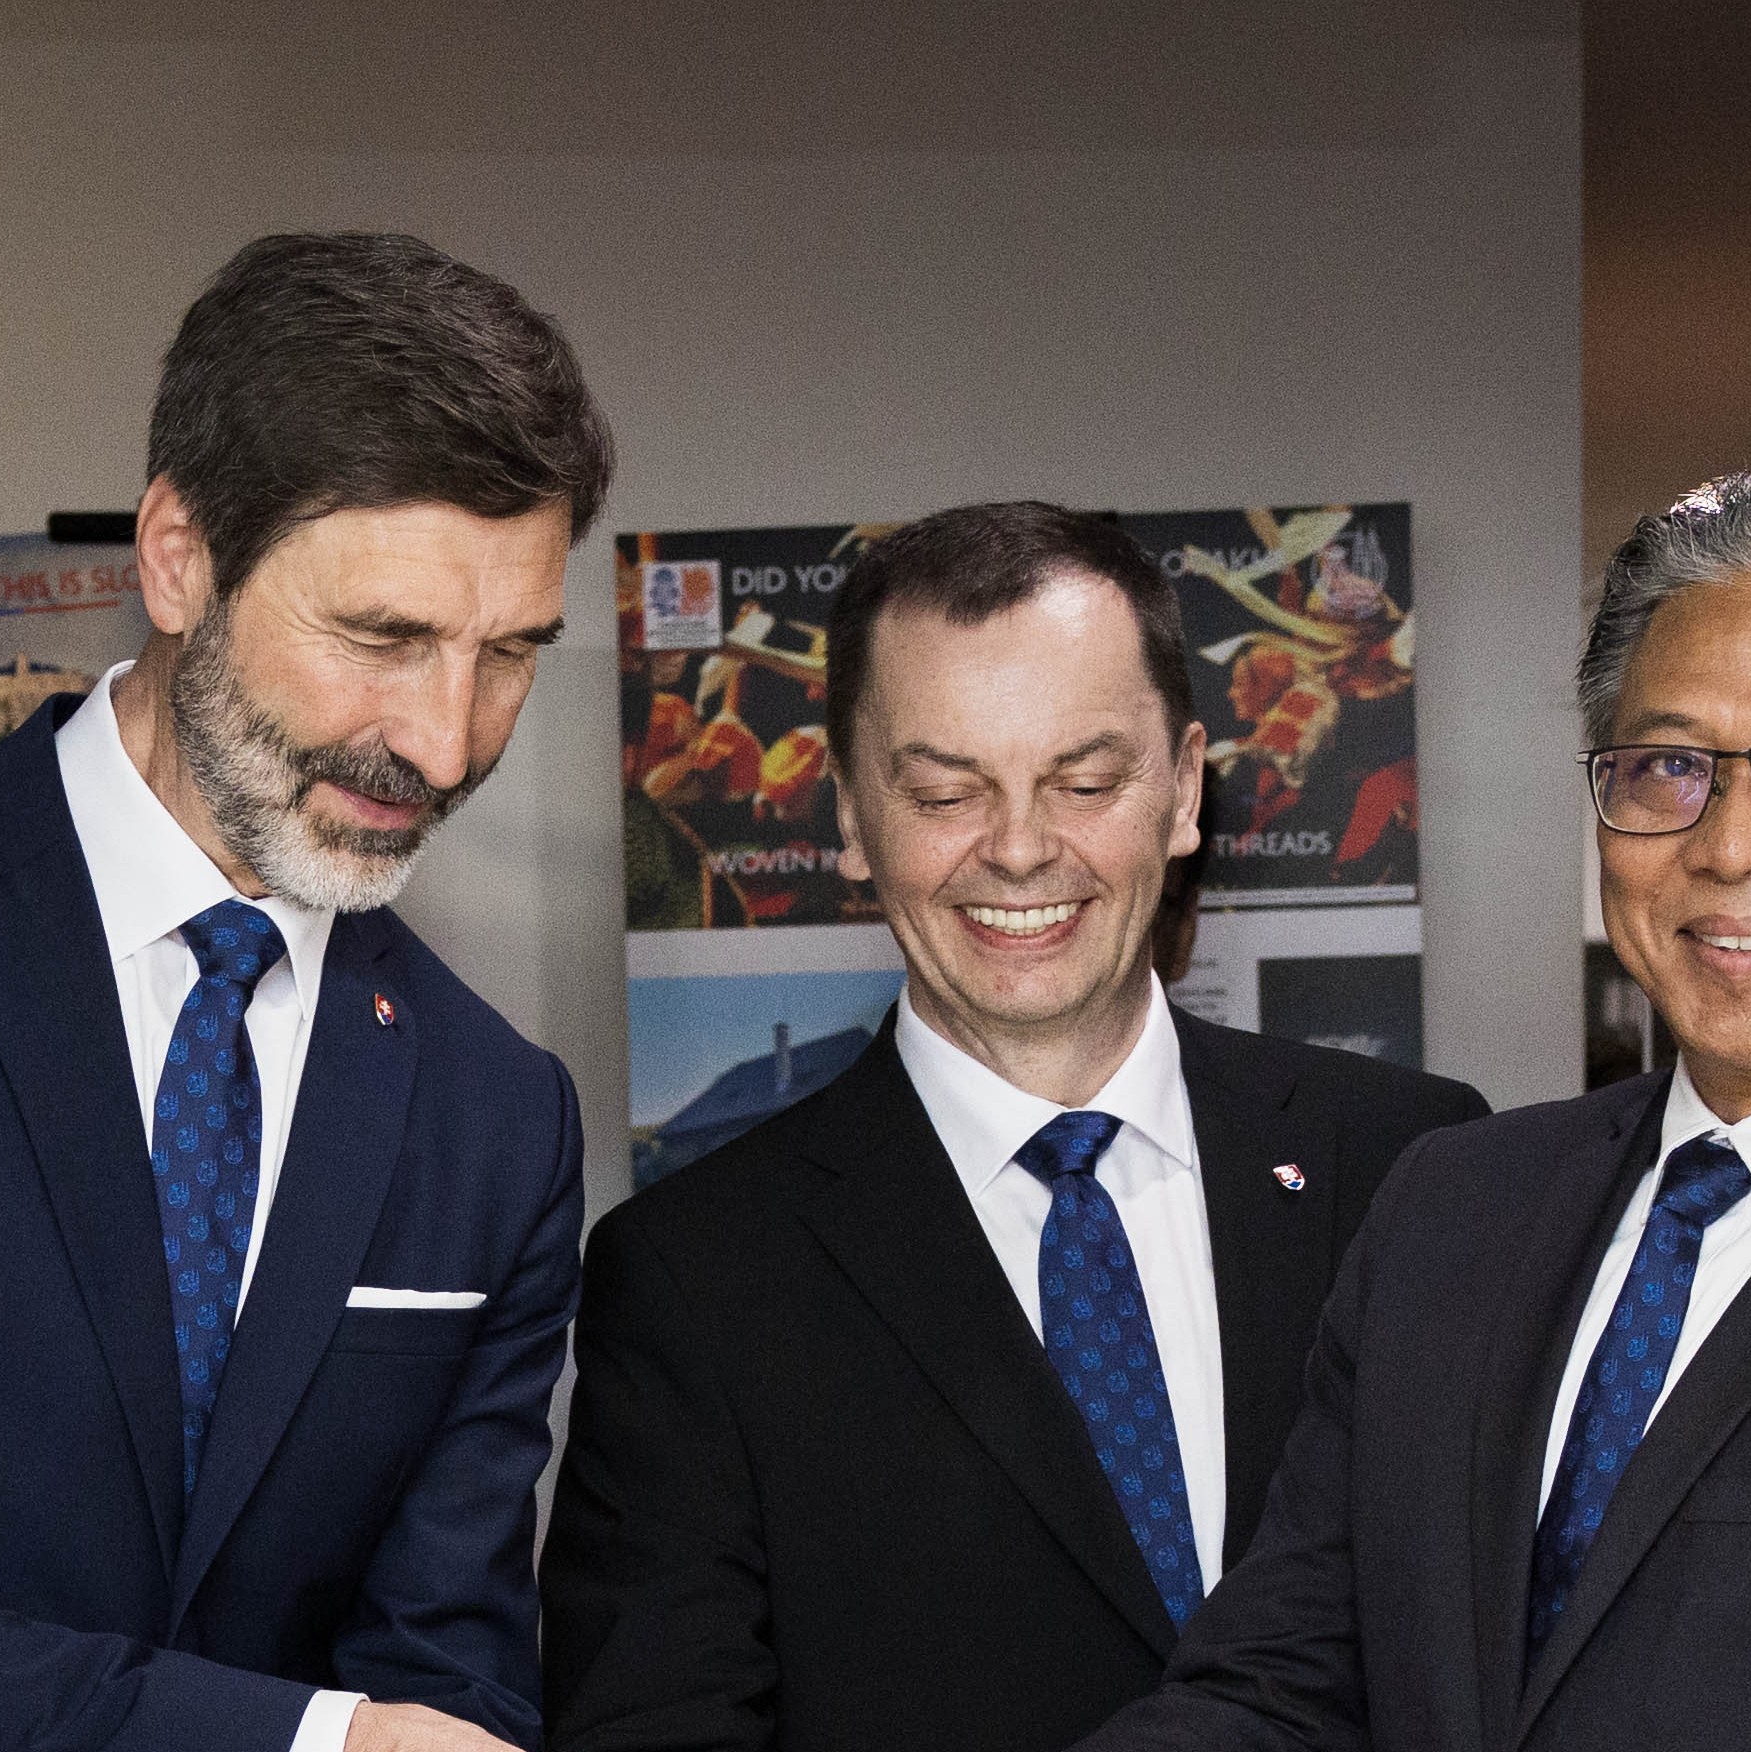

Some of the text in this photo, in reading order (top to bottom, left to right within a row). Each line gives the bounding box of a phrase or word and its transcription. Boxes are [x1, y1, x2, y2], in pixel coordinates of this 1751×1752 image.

[59, 570, 84, 595] IS
[732, 565, 788, 596] DID
[1213, 831, 1333, 857] THREADS
[707, 847, 816, 874] WOVEN
